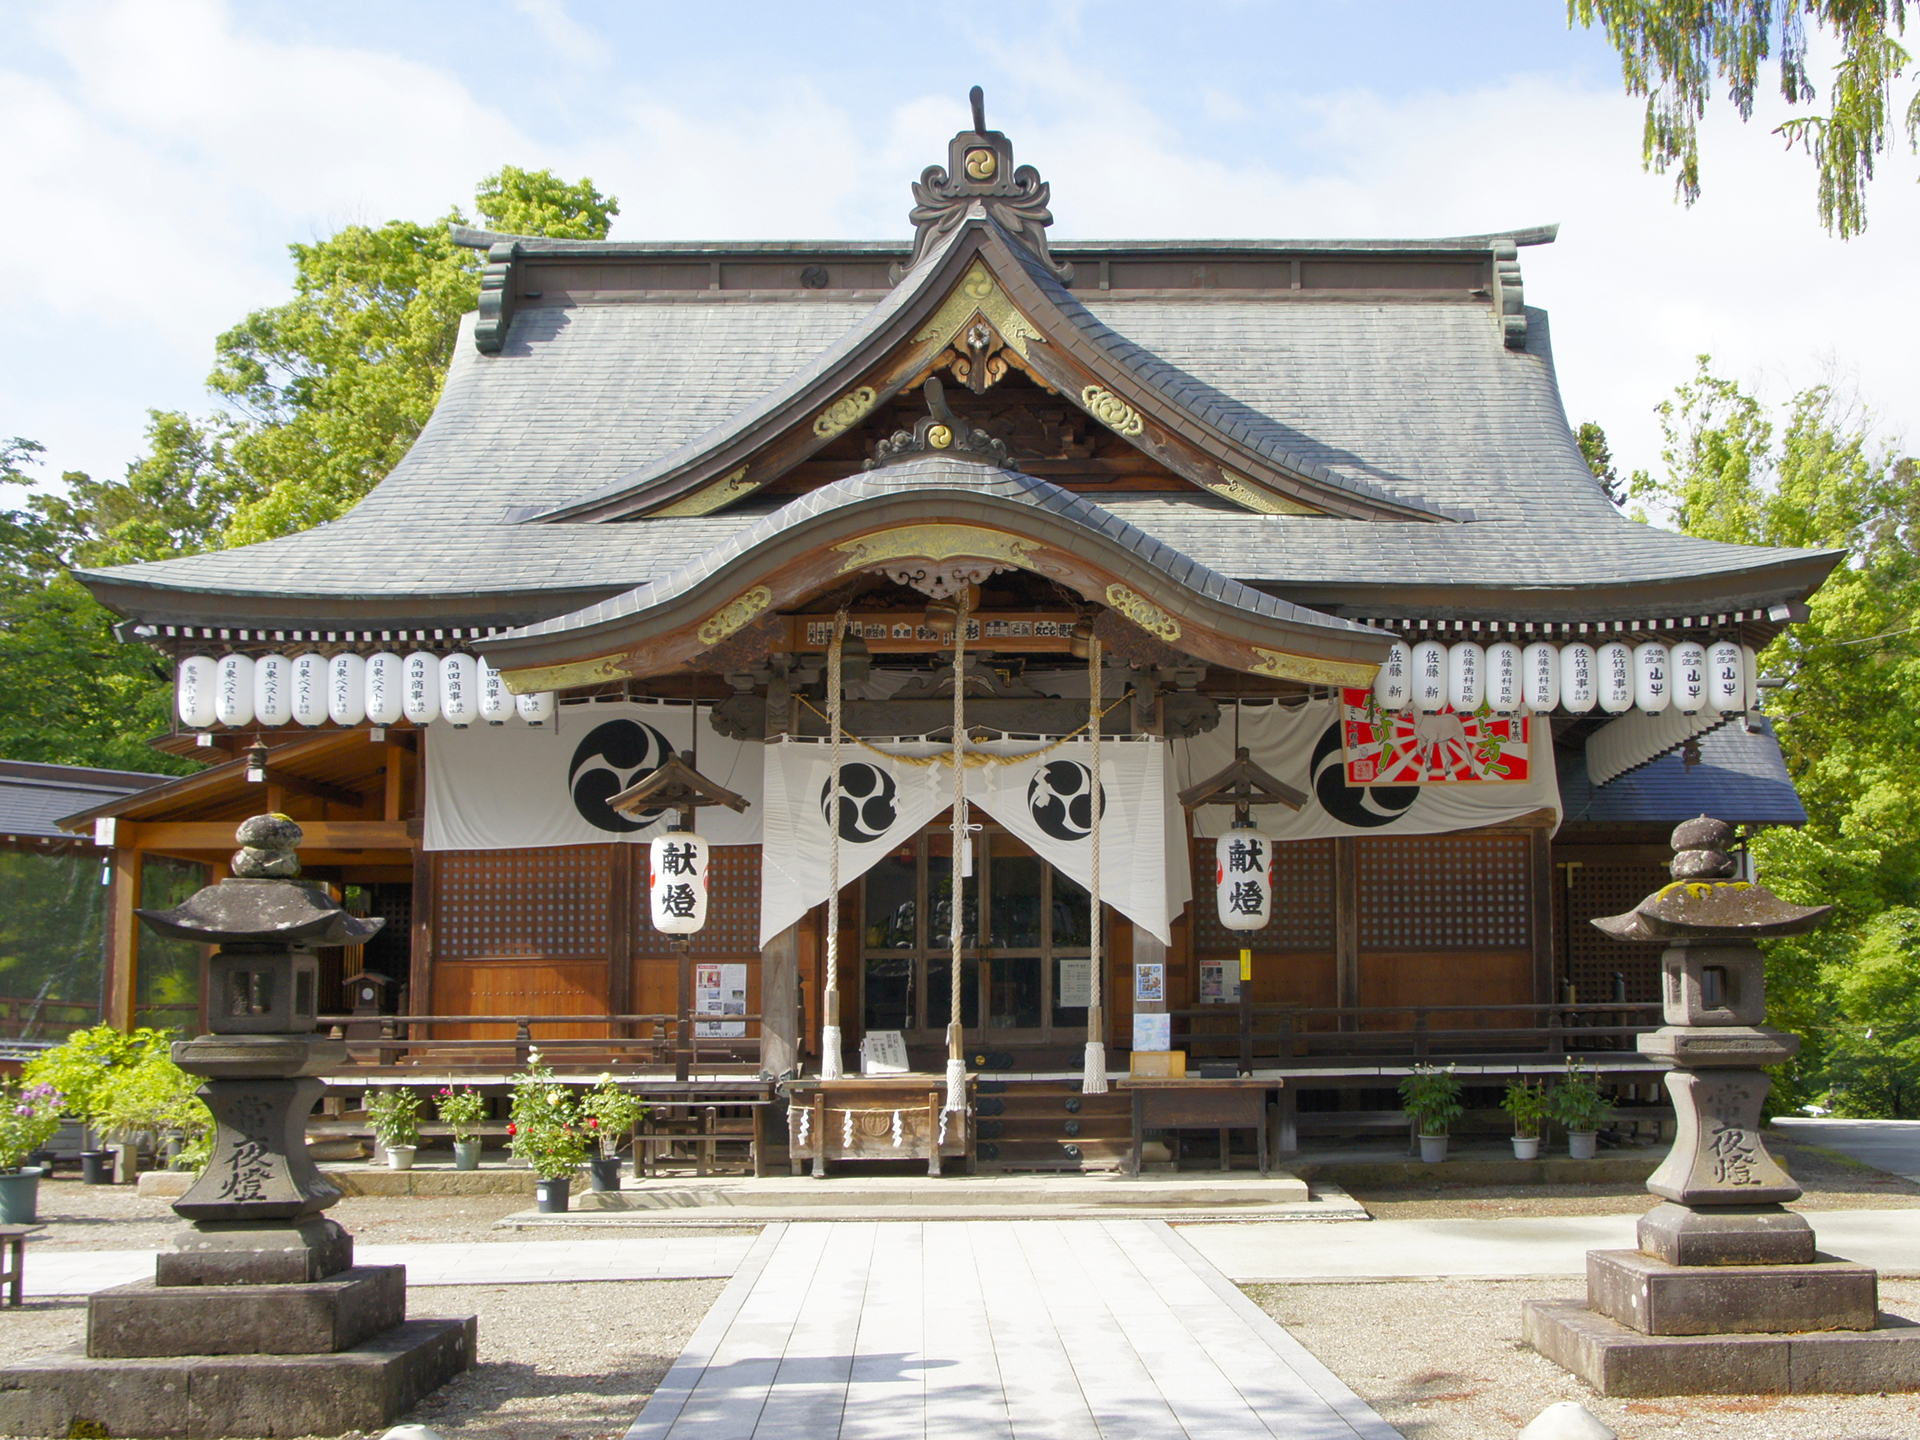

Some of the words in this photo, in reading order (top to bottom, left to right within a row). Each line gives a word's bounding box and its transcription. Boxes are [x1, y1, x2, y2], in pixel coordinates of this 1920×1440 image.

[224, 661, 237, 703] 日東ベスト
[265, 661, 278, 703] 日東ベスト
[298, 660, 311, 703] 日東ベスト
[336, 660, 348, 702] 日東ベスト
[372, 659, 385, 701] 日東ベスト
[486, 670, 500, 698] 田商事
[1388, 650, 1402, 677] 佐藤
[1425, 651, 1440, 677] 佐藤
[1462, 649, 1475, 702] 佐藤歯科医院
[1500, 650, 1513, 703] 佐藤歯科医院
[1538, 649, 1550, 702] 佐藤歯科医院
[1574, 649, 1588, 688] 佐竹商事
[1611, 649, 1627, 688] 佐竹商事
[1388, 685, 1402, 698] 新
[1425, 686, 1439, 698] 新
[662, 842, 698, 919] 献燈
[1228, 838, 1265, 916] 献燈
